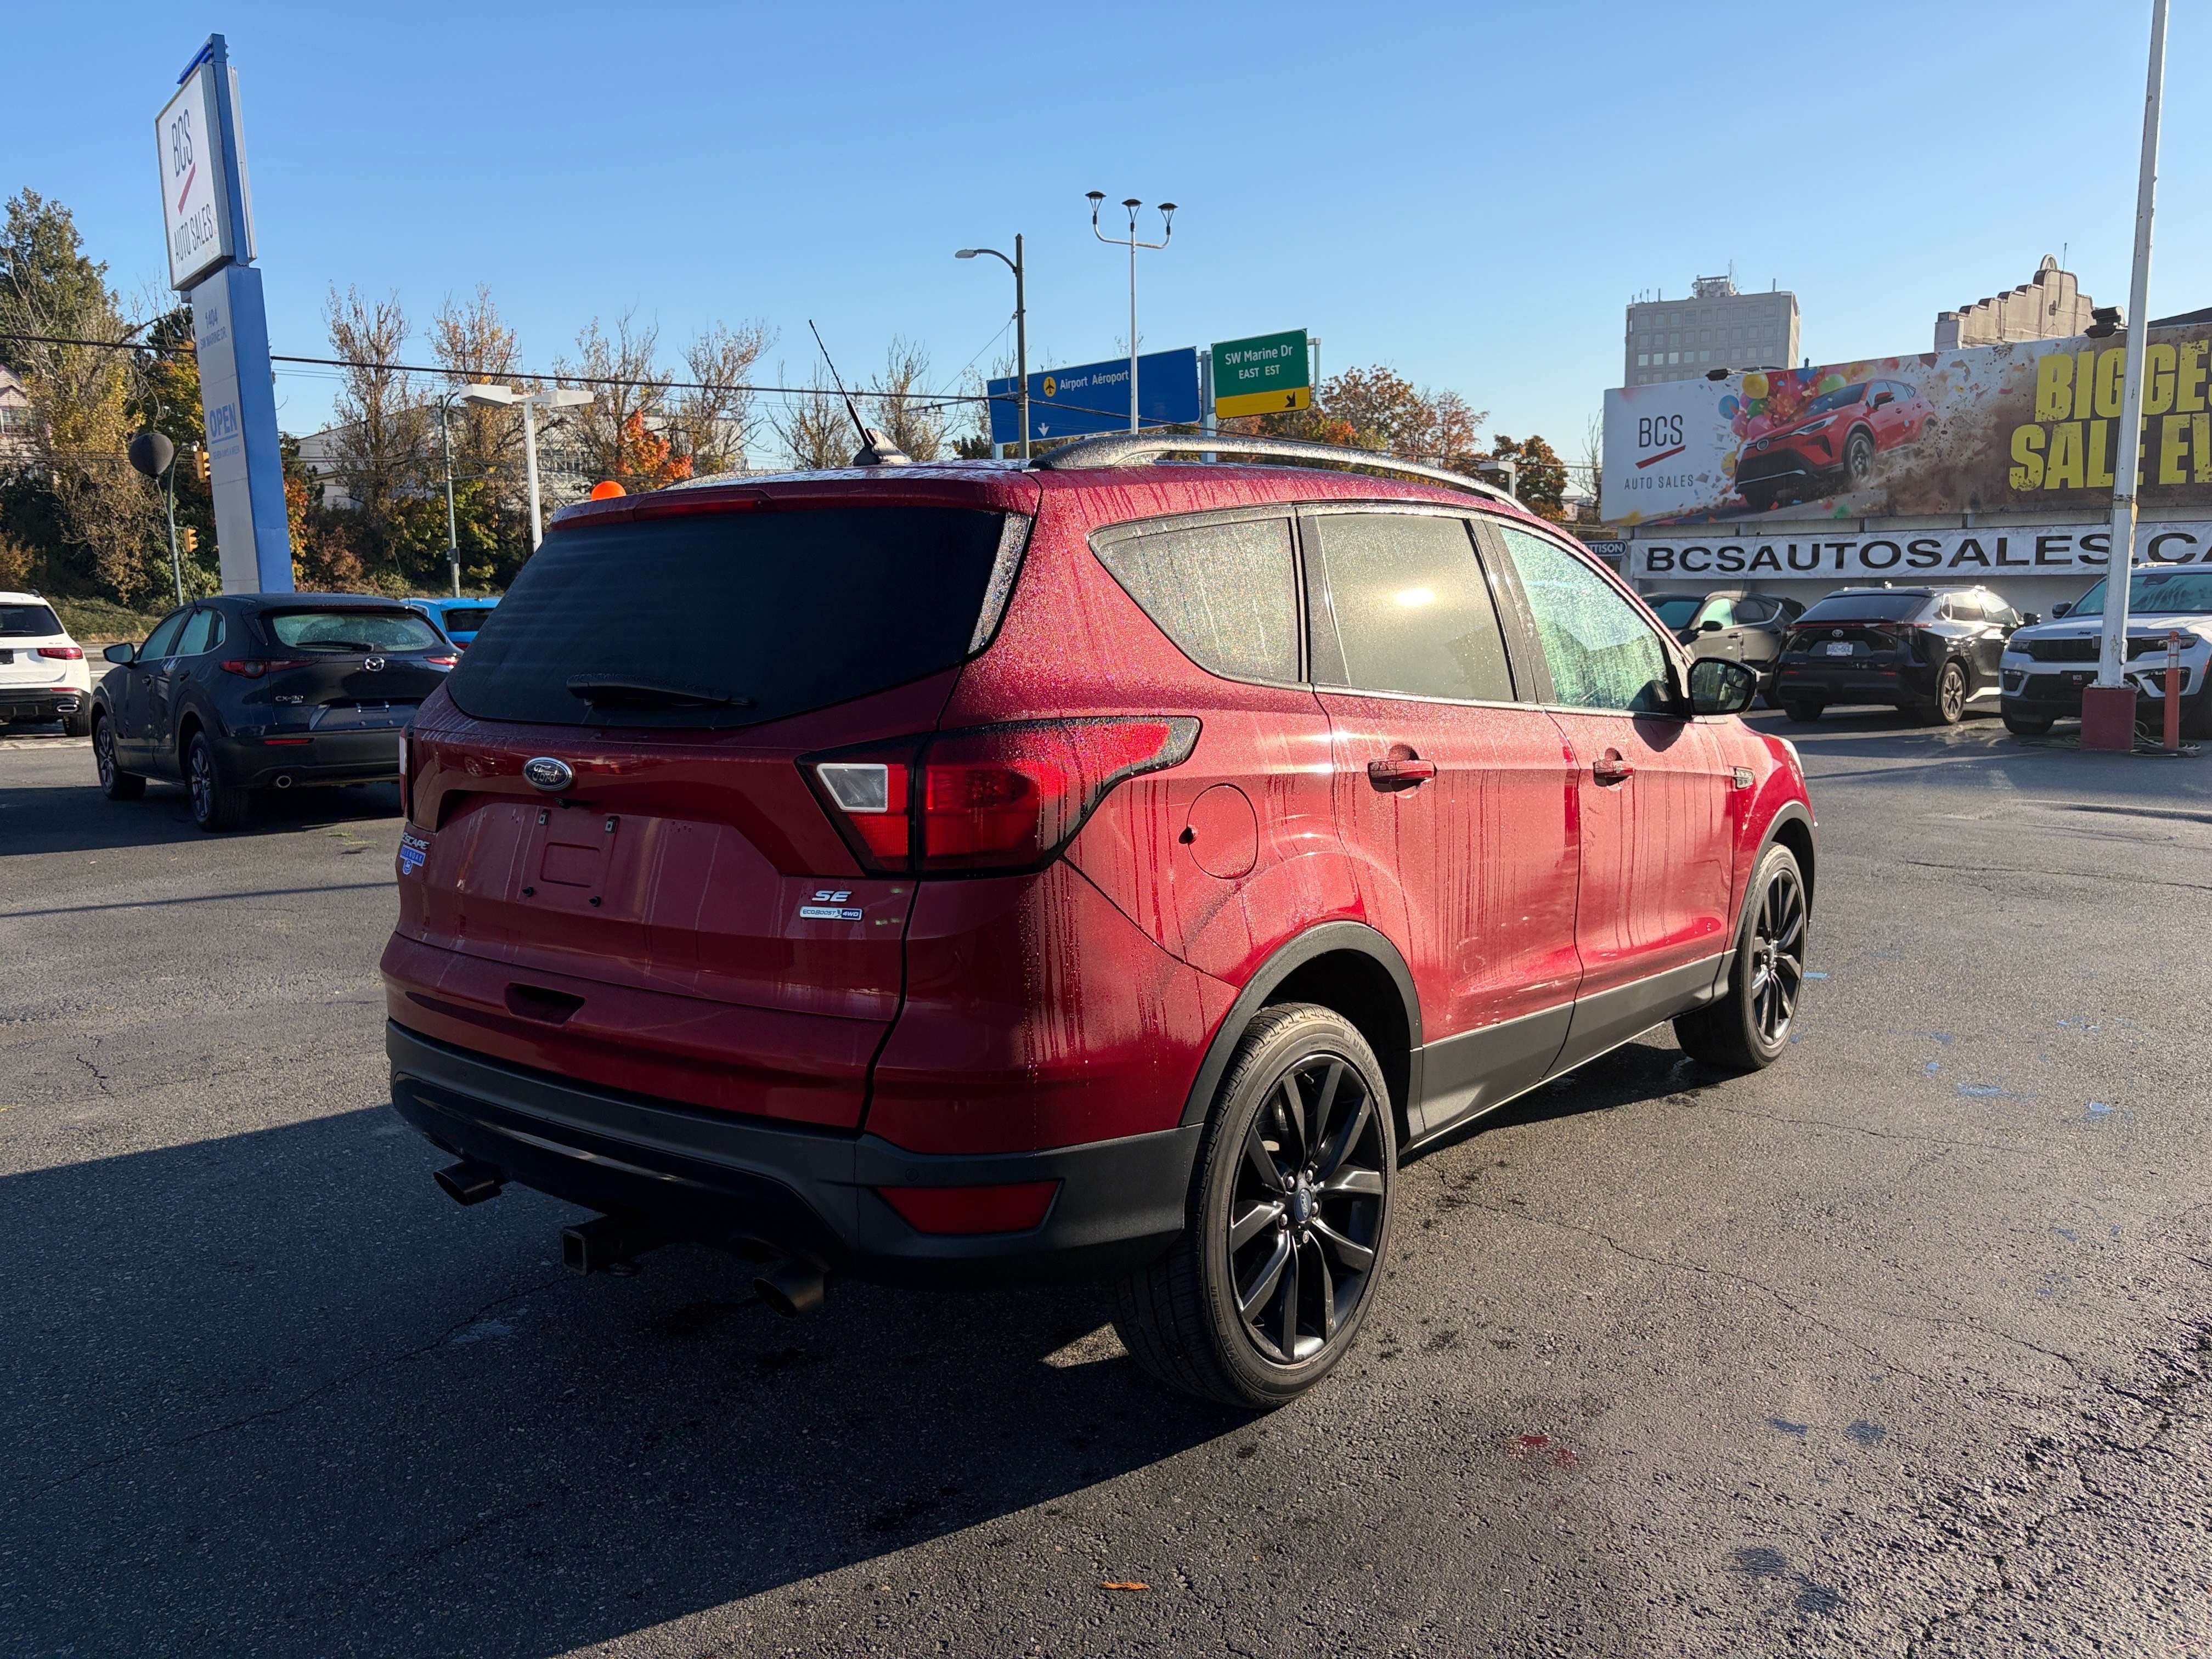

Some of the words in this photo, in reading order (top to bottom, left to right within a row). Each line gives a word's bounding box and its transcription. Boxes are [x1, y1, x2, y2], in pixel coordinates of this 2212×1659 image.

[171, 109, 193, 178] BCS
[174, 221, 191, 264] AUTO
[190, 203, 213, 251] SALES
[1224, 351, 1242, 365] SW
[1244, 347, 1278, 363] Marine
[1280, 345, 1293, 357] Dr
[1059, 376, 1088, 392] Airport
[1092, 370, 1130, 386] Aéroport
[1238, 367, 1260, 380] EAST
[1265, 364, 1280, 376] EST
[2035, 339, 2212, 423] BIGGE
[210, 402, 238, 438] OPEN
[1639, 414, 1683, 448] BCS
[1624, 477, 1652, 490] AUTO
[1657, 474, 1694, 489] SALES
[1646, 532, 2212, 572] BCSAUTOSALES.C
[532, 764, 559, 783] Ford
[403, 832, 431, 850] ESCAPE
[811, 890, 853, 902] SE
